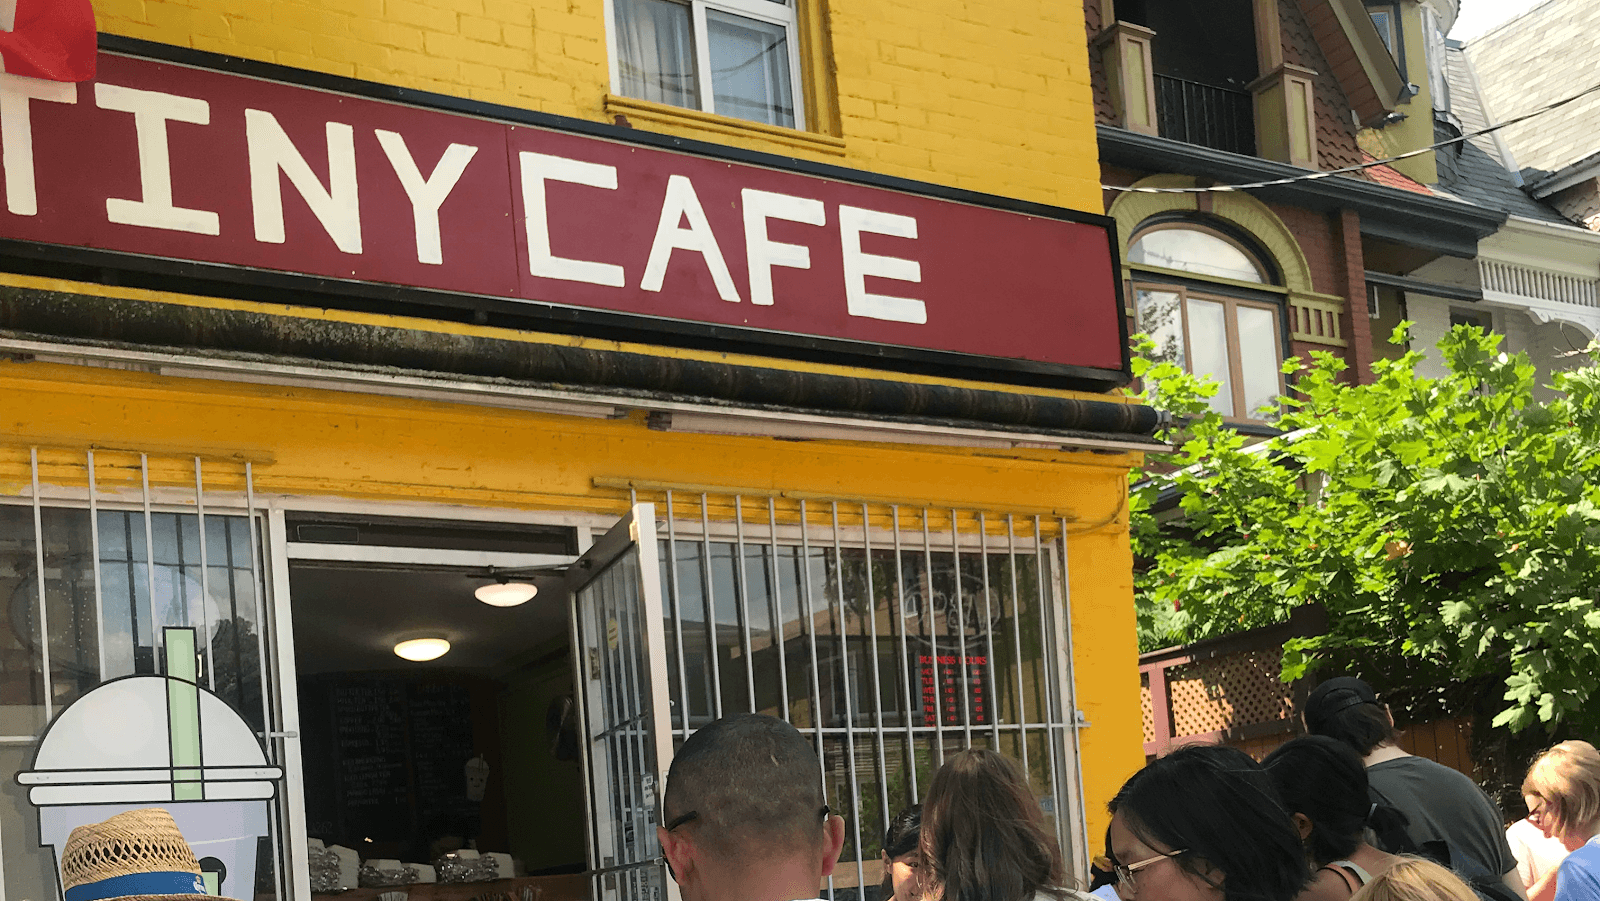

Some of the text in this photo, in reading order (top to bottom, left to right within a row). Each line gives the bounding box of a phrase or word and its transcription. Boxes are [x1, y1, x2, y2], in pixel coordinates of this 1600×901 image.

[0, 76, 928, 325] TINY CAFE
[919, 655, 956, 665] BUSNESS
